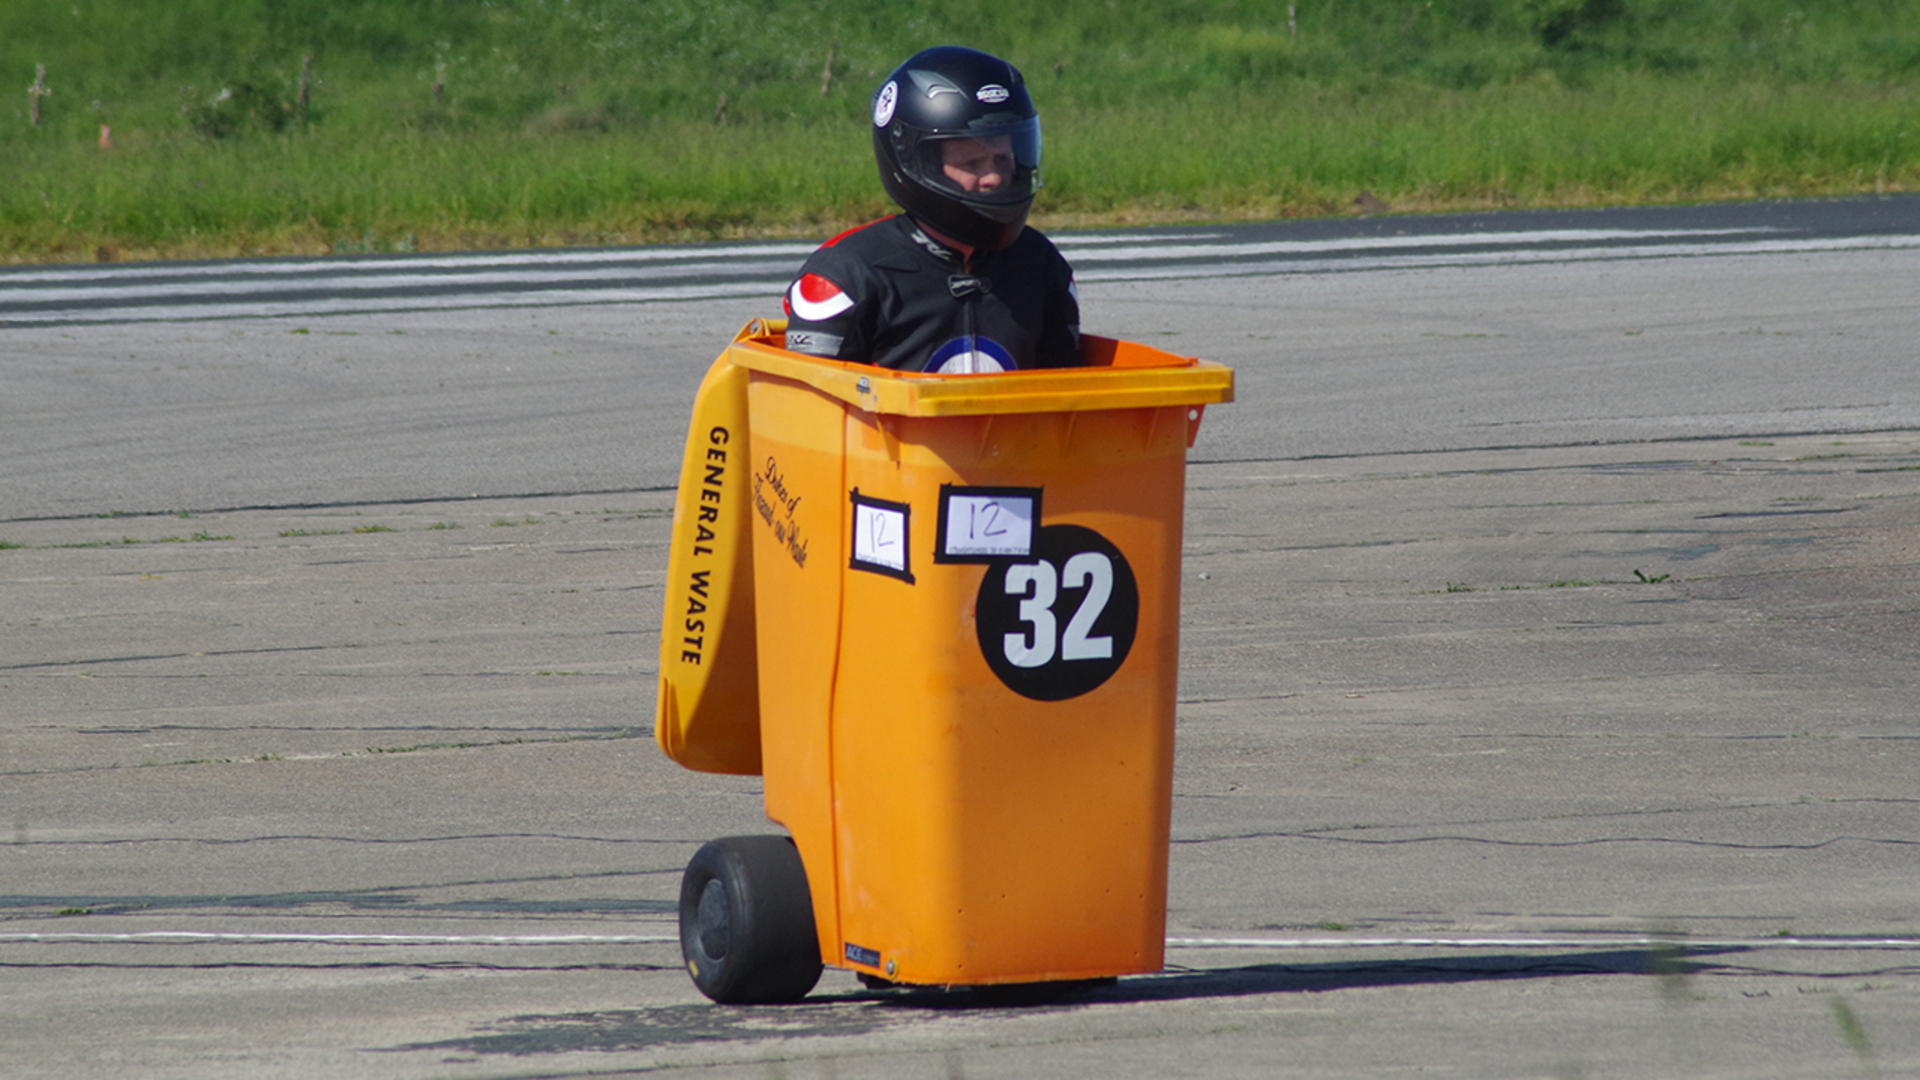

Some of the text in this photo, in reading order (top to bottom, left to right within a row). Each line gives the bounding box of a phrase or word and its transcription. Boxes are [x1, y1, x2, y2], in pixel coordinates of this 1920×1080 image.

[785, 496, 801, 519] of
[969, 501, 1008, 540] 12
[681, 426, 729, 665] GENERAL WASTE
[869, 512, 895, 553] 12
[1003, 552, 1113, 668] 32
